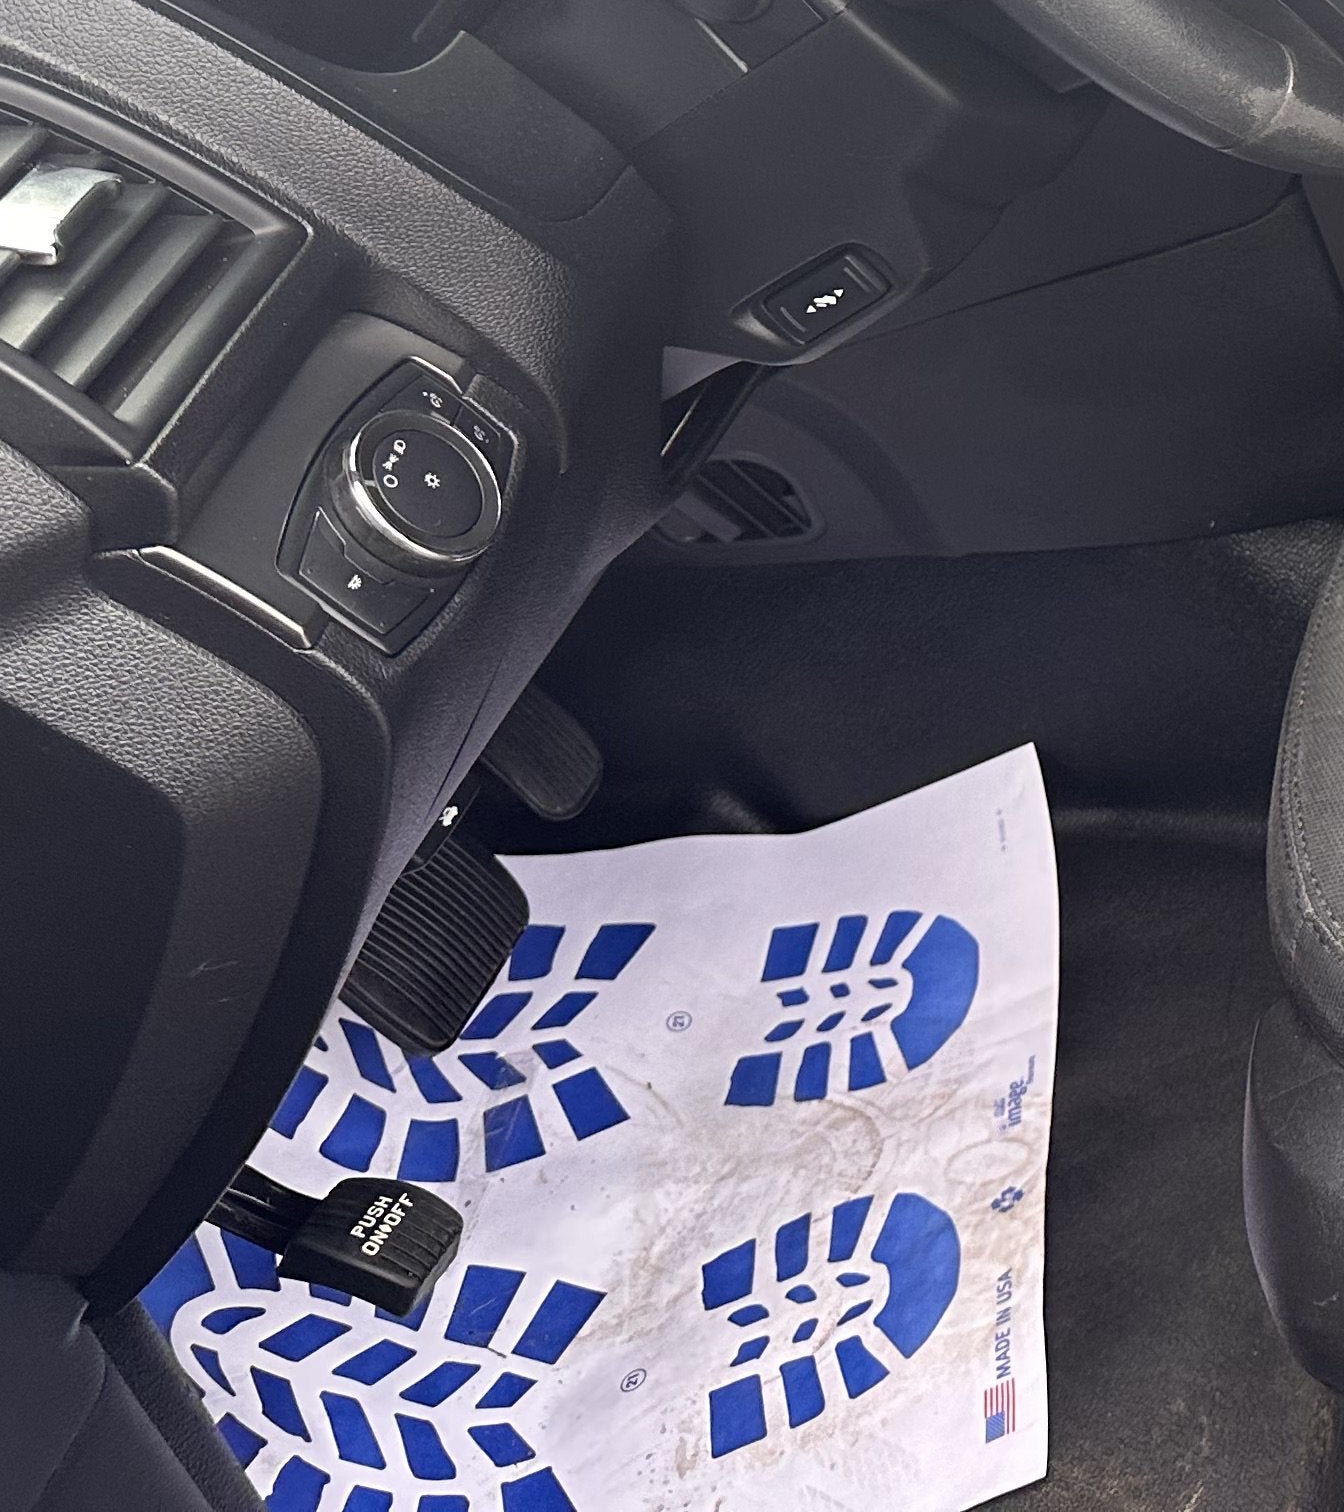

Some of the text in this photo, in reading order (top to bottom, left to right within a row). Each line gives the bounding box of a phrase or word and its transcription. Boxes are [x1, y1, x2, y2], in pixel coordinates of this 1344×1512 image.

[1000, 1078, 1028, 1128] image
[349, 1195, 394, 1239] PUSH
[361, 1192, 414, 1256] ON OFF
[995, 1268, 1013, 1380] MADE IN USA
